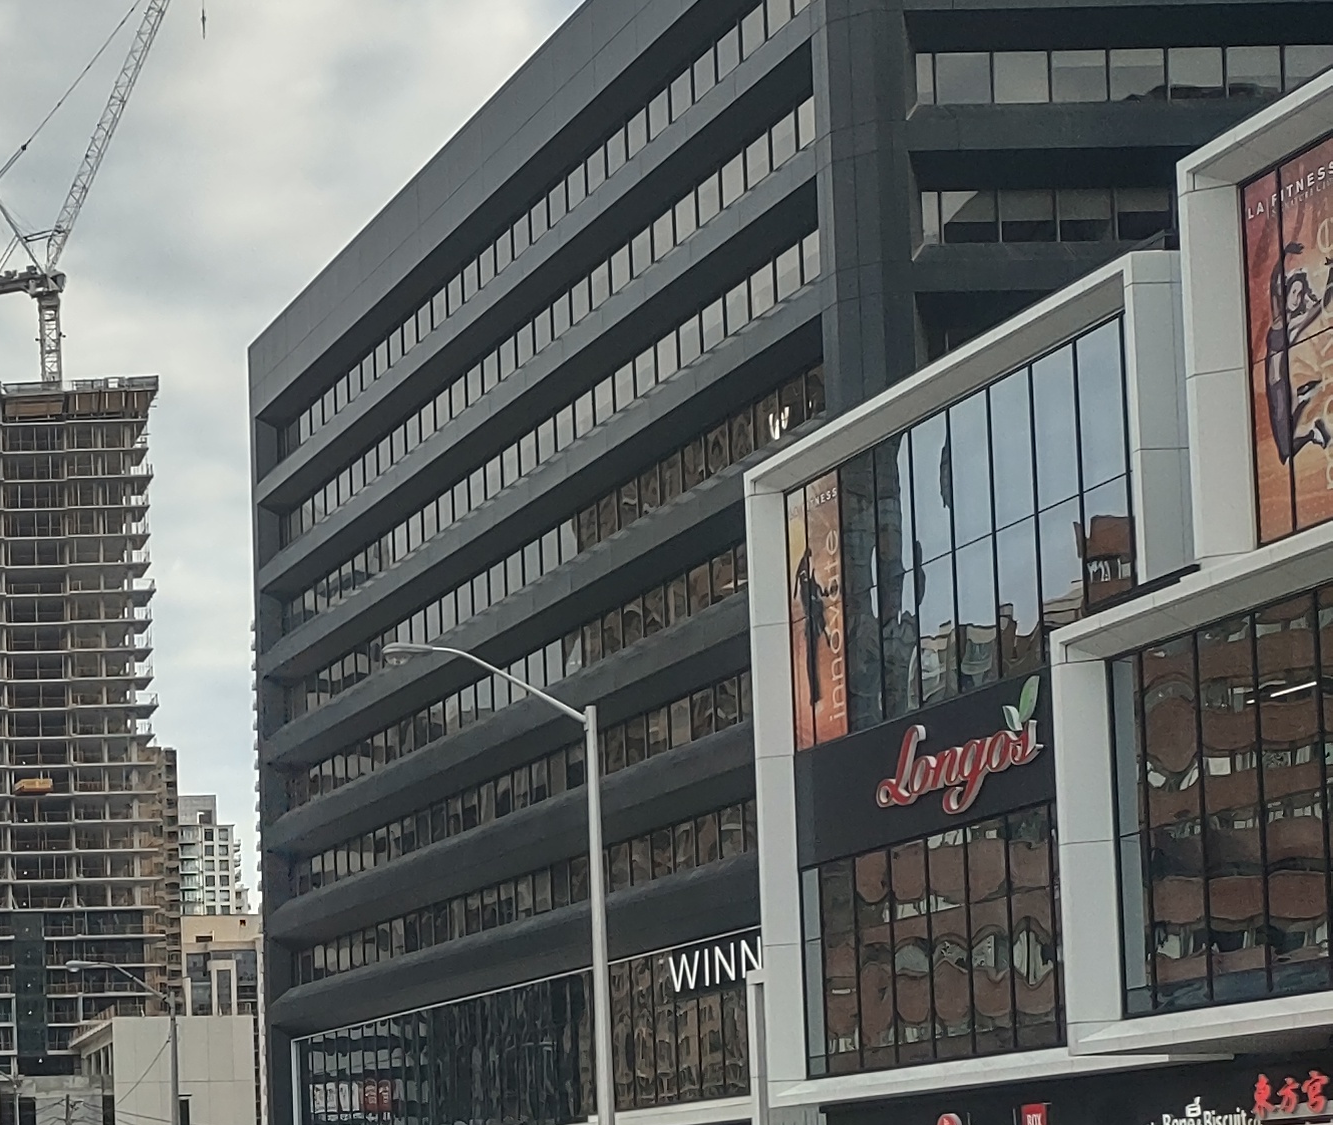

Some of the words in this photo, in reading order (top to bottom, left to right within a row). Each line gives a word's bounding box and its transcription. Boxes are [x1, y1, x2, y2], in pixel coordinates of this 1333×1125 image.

[1247, 201, 1264, 220] LA
[1271, 160, 1333, 207] FITNESS
[824, 530, 847, 722] innovate
[668, 935, 762, 992] WINN
